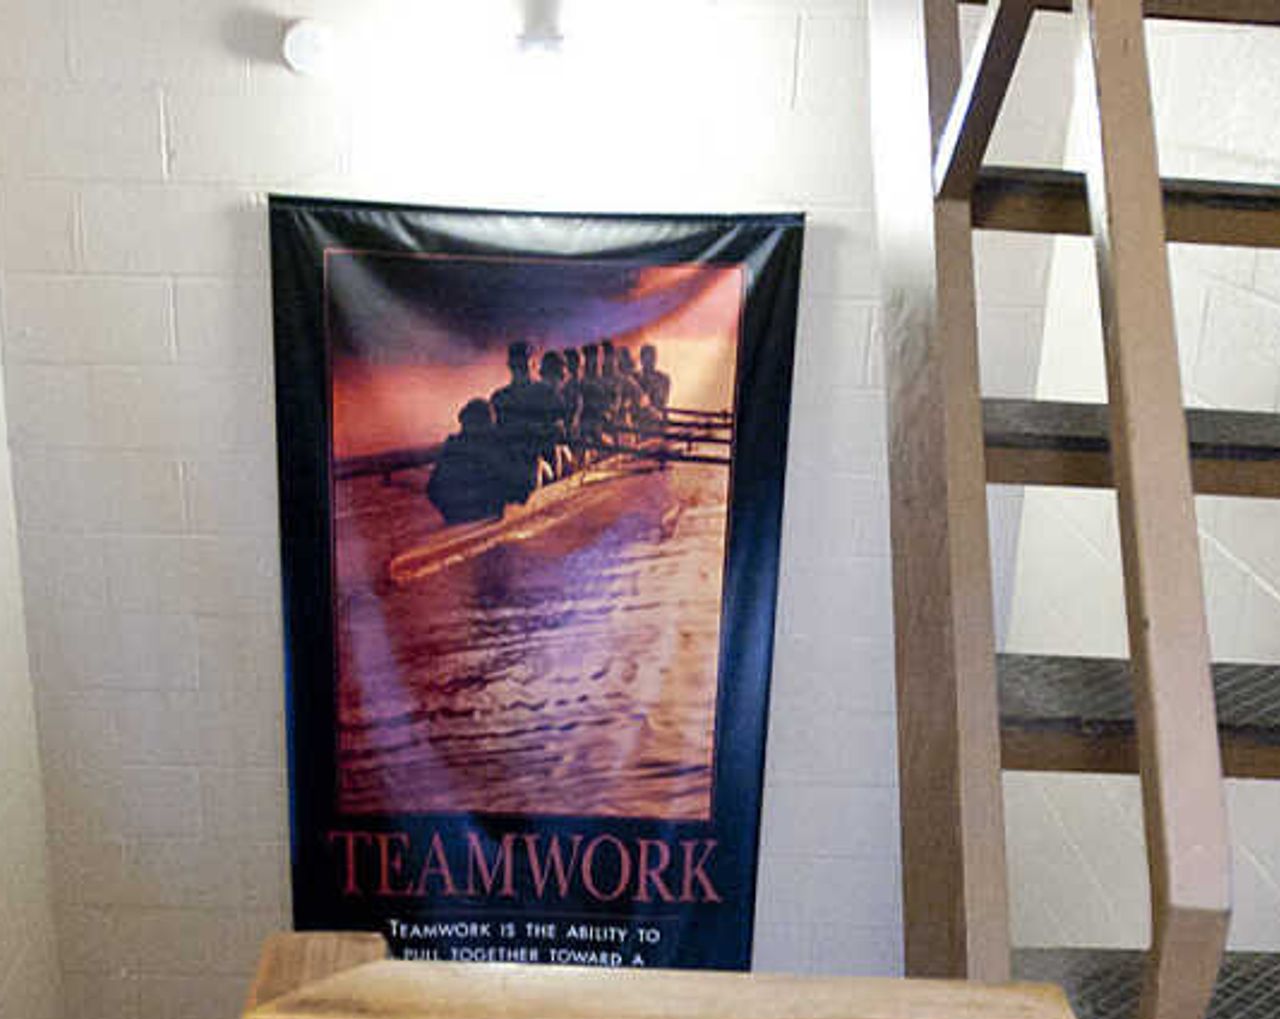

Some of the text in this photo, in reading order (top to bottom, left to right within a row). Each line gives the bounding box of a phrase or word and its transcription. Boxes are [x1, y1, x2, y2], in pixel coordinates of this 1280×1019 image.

[330, 831, 721, 902] TEAMWORK
[389, 919, 661, 944] TEAMWORK IS THE ABILITY TO
[450, 946, 539, 962] TOGETHER
[549, 947, 622, 966] TOWARD
[632, 953, 644, 966] A
